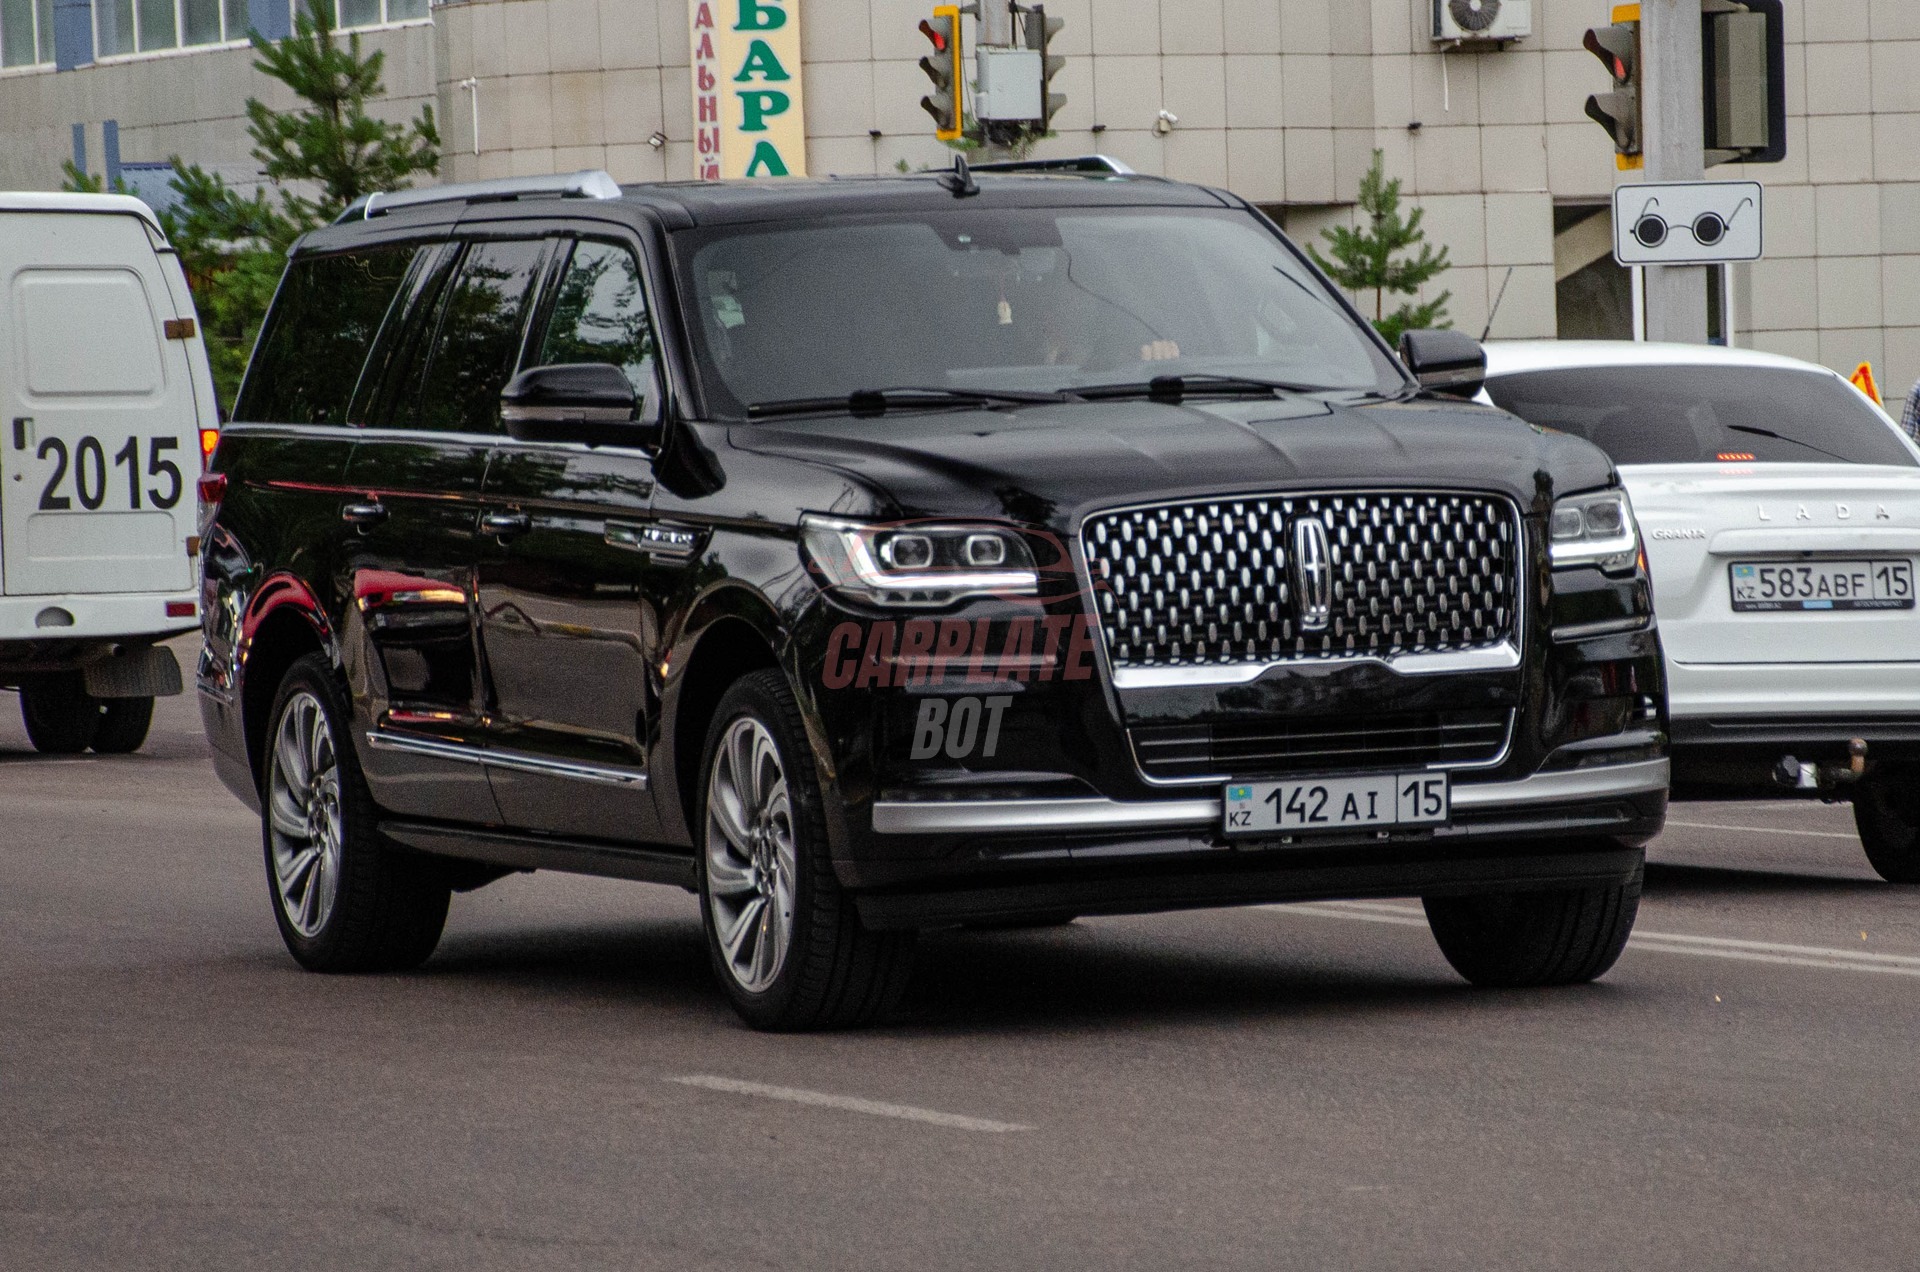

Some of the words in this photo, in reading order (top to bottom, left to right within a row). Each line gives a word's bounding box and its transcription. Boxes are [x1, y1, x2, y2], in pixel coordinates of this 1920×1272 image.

[37, 436, 182, 510] 2015
[1757, 503, 1891, 521] LADA
[1651, 527, 1706, 541] GRANTA
[1876, 566, 1909, 597] 15
[1229, 810, 1252, 827] KZ
[1402, 779, 1444, 818] 15
